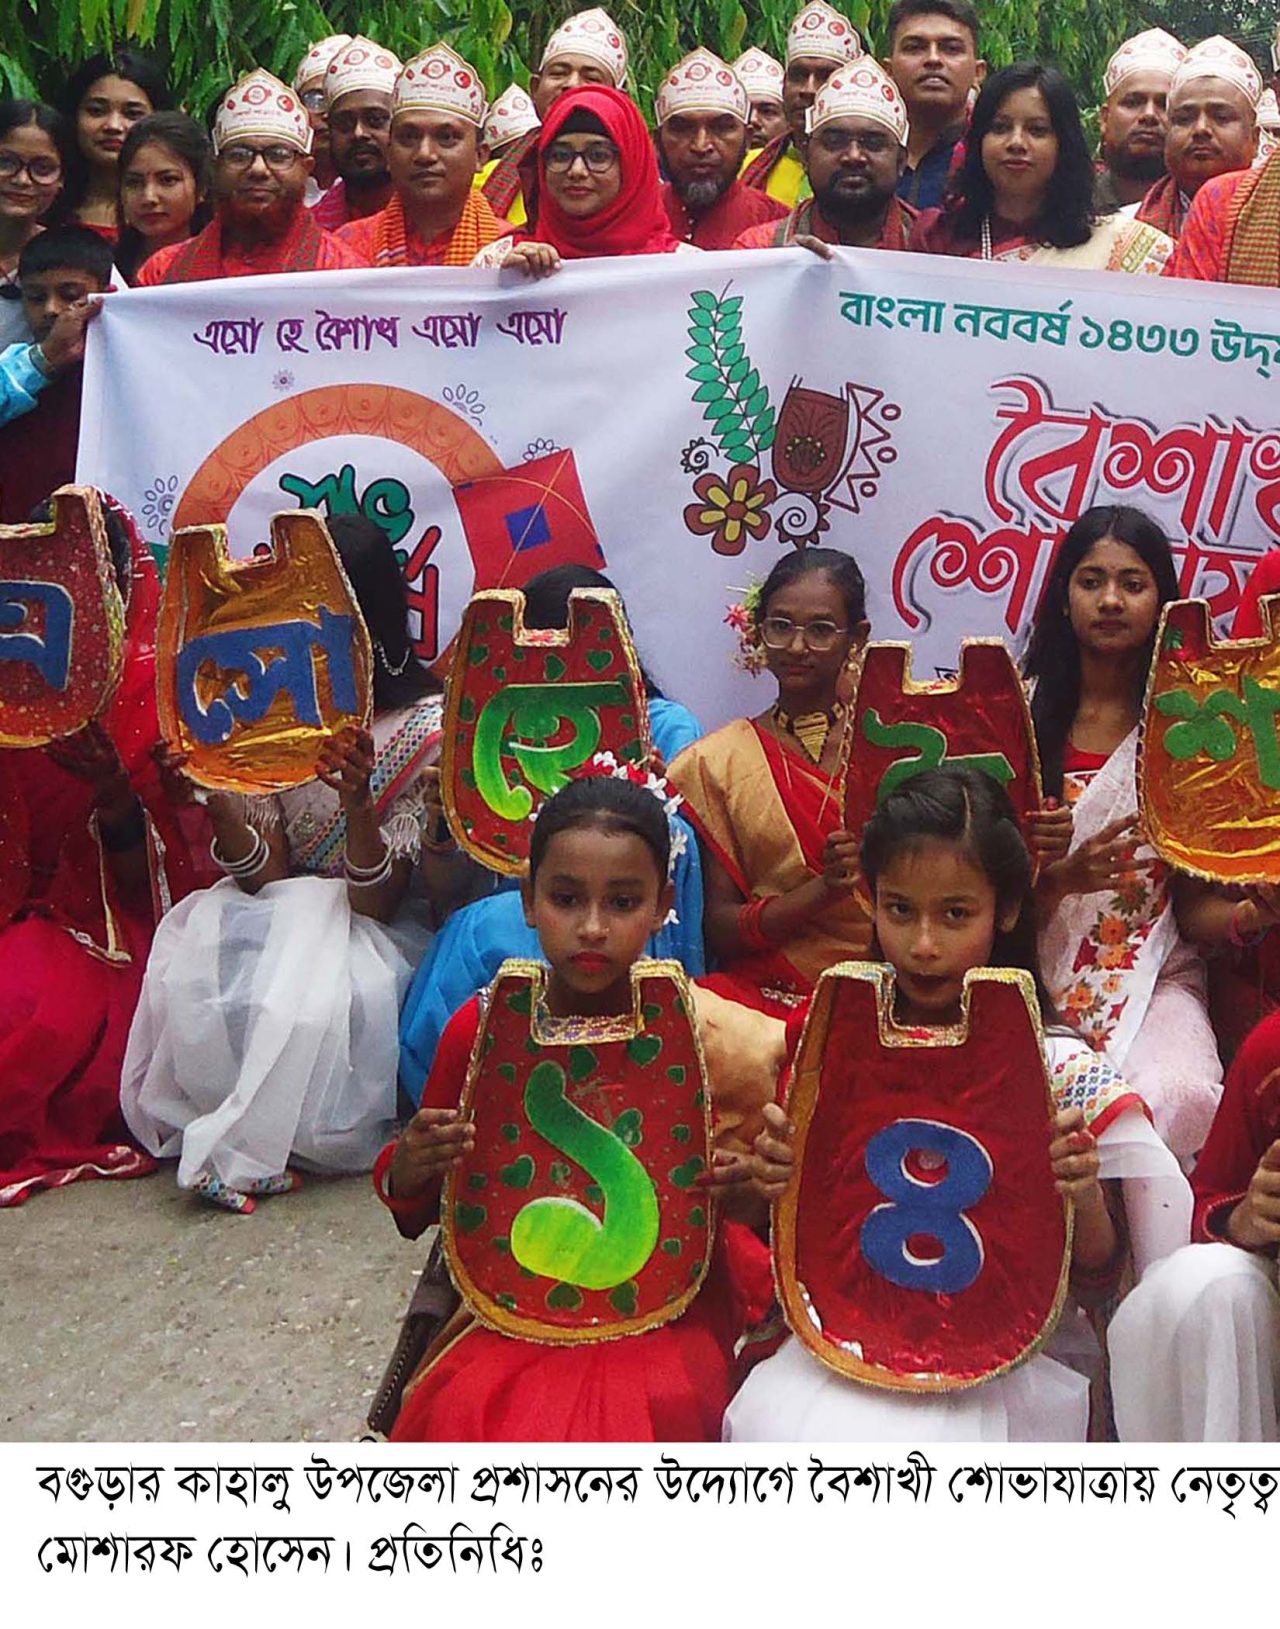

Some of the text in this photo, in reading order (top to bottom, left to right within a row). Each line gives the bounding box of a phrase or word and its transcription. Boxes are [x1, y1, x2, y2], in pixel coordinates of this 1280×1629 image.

[194, 308, 567, 354] এসো হে বৈশাখ এসো এসো
[839, 291, 947, 333] বাংলা
[953, 300, 1073, 346] নববর্ষ
[1079, 316, 1200, 357] ১৪৩৩
[177, 604, 357, 743] সো
[511, 1059, 660, 1290] ১
